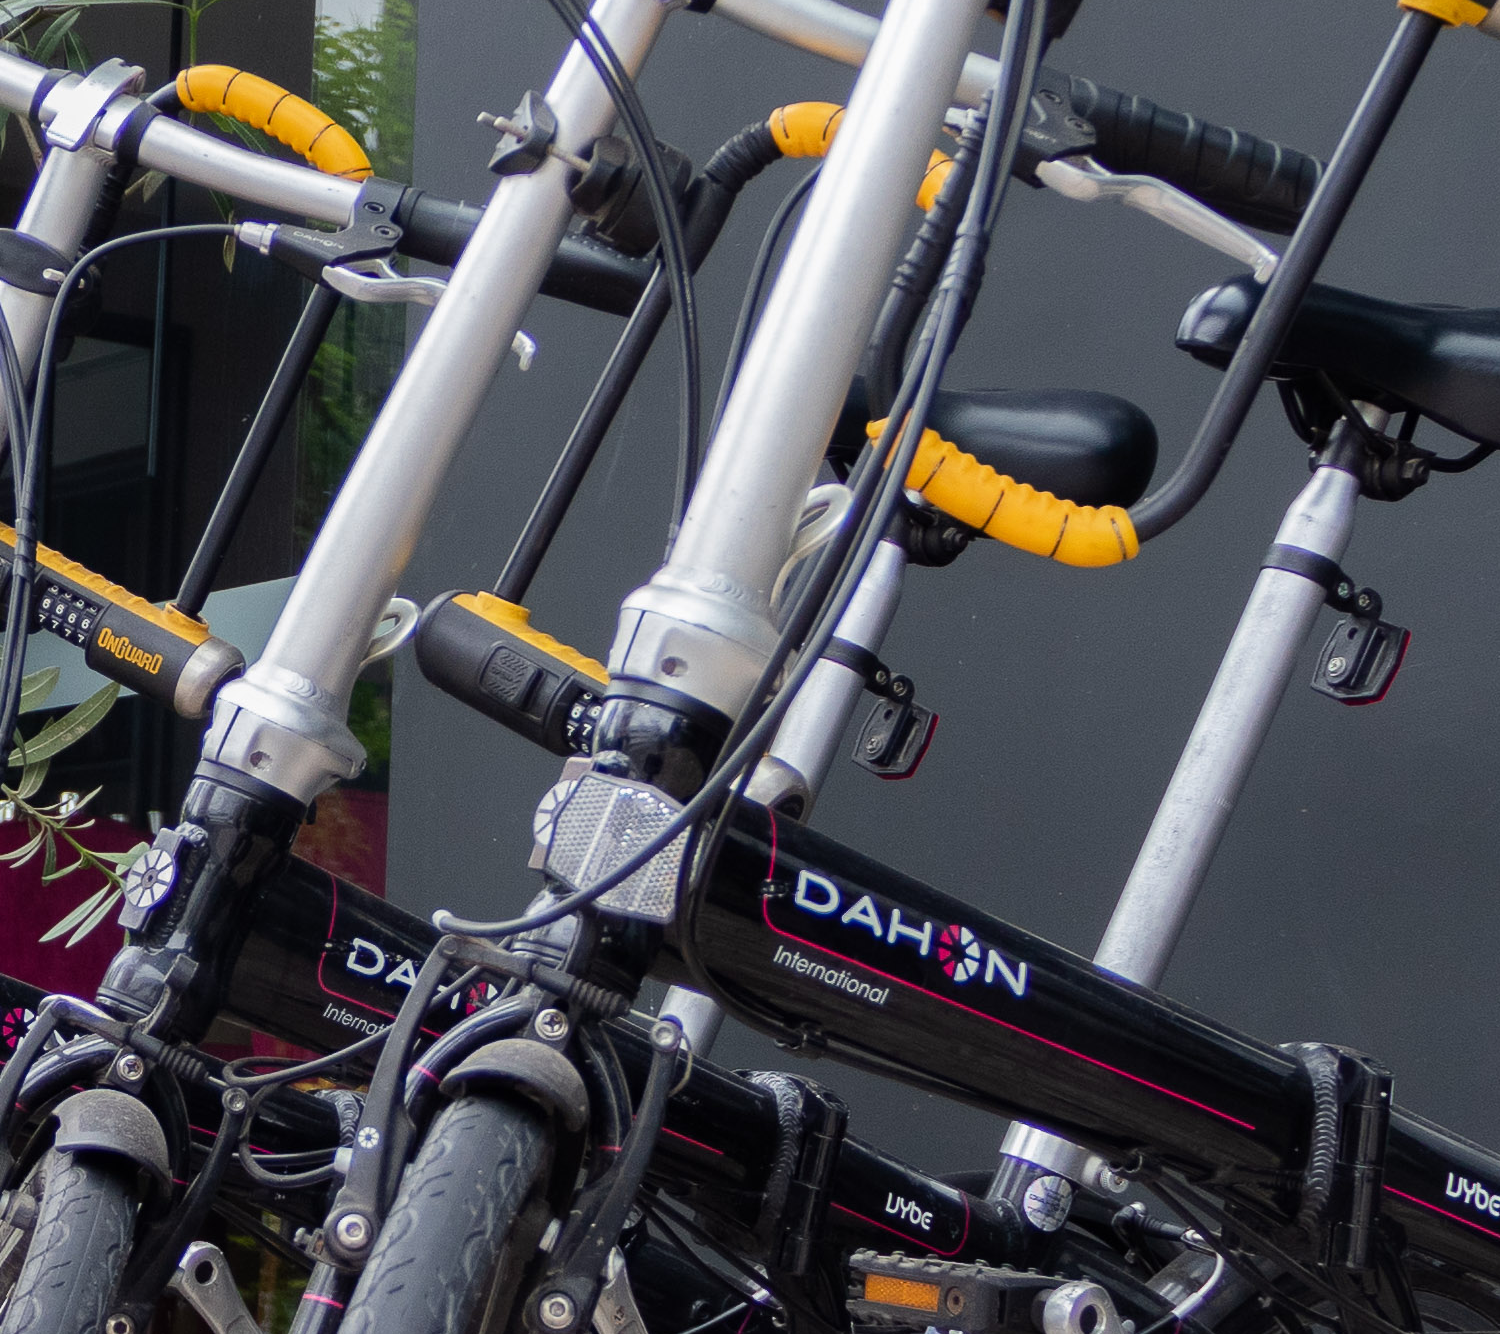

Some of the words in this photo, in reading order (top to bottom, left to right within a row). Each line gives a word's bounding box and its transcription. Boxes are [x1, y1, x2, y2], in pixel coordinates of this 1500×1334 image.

[293, 231, 344, 249] DAHON
[42, 598, 91, 629] 6666
[795, 869, 1027, 997] DAHON
[773, 945, 889, 1005] International
